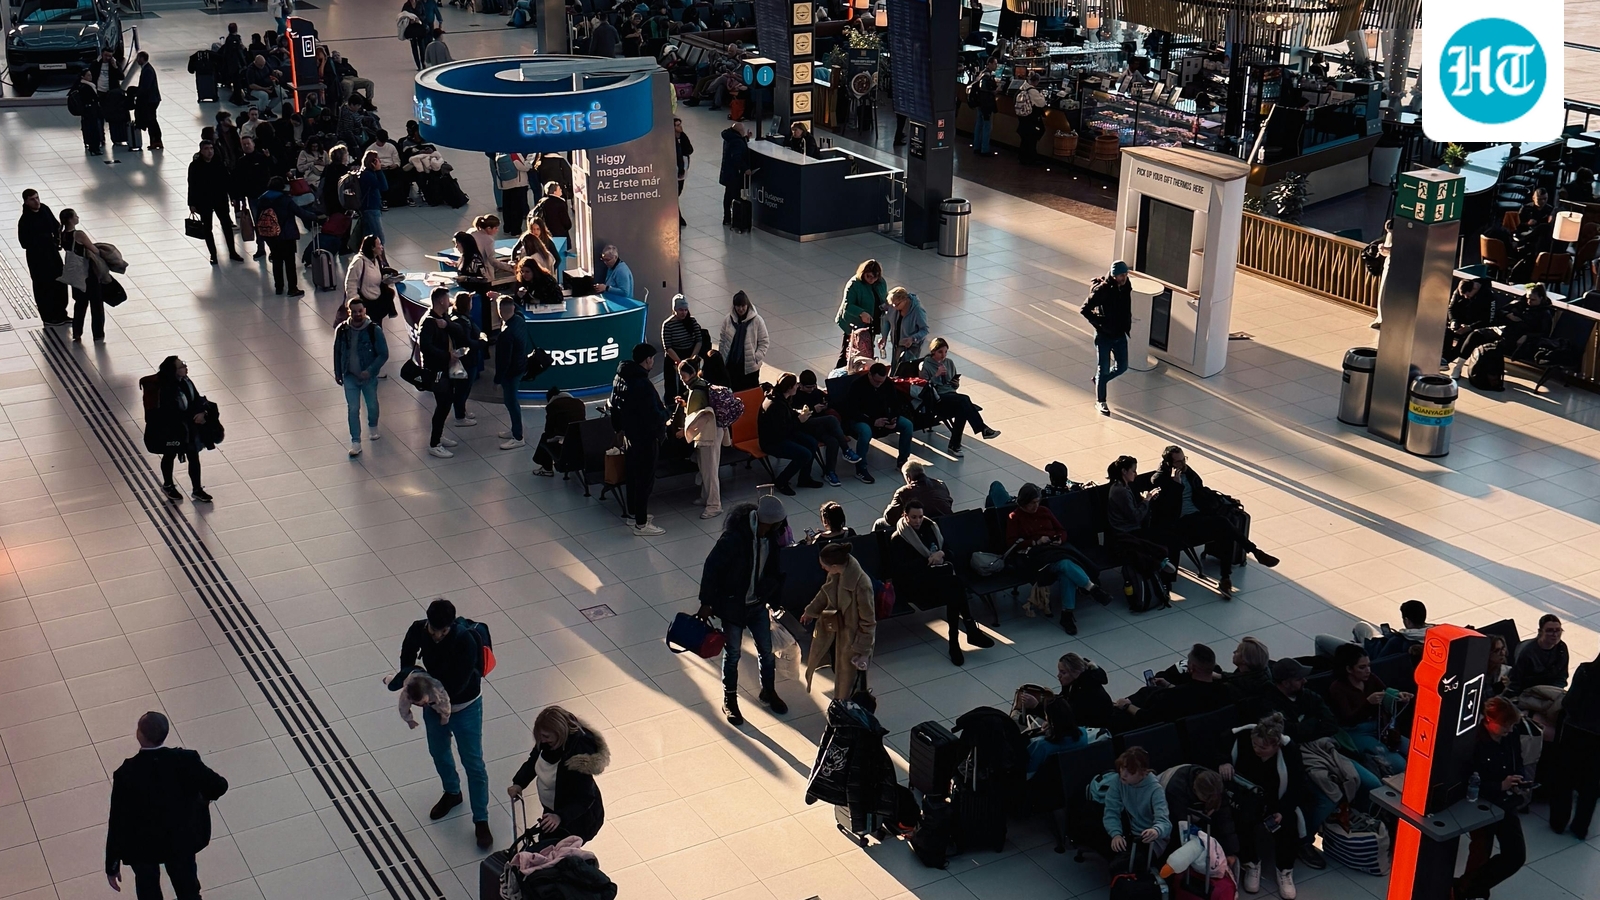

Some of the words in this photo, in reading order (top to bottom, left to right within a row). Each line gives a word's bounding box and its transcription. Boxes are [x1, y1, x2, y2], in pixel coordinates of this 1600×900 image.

[522, 112, 587, 136] ERSTE
[596, 153, 626, 166] Higgy
[596, 163, 653, 178] magadban!
[597, 180, 611, 190] Az
[613, 178, 639, 189] Erste
[641, 175, 661, 187] már
[1136, 167, 1146, 176] PICK
[1146, 170, 1152, 178] UP
[1153, 172, 1163, 182] YOUR
[1163, 175, 1173, 185] GIFT
[1172, 177, 1192, 191] THERMOS
[1192, 184, 1205, 195] HERE
[597, 193, 619, 203] hisz
[620, 188, 661, 201] benned.
[544, 346, 599, 366] RSTE
